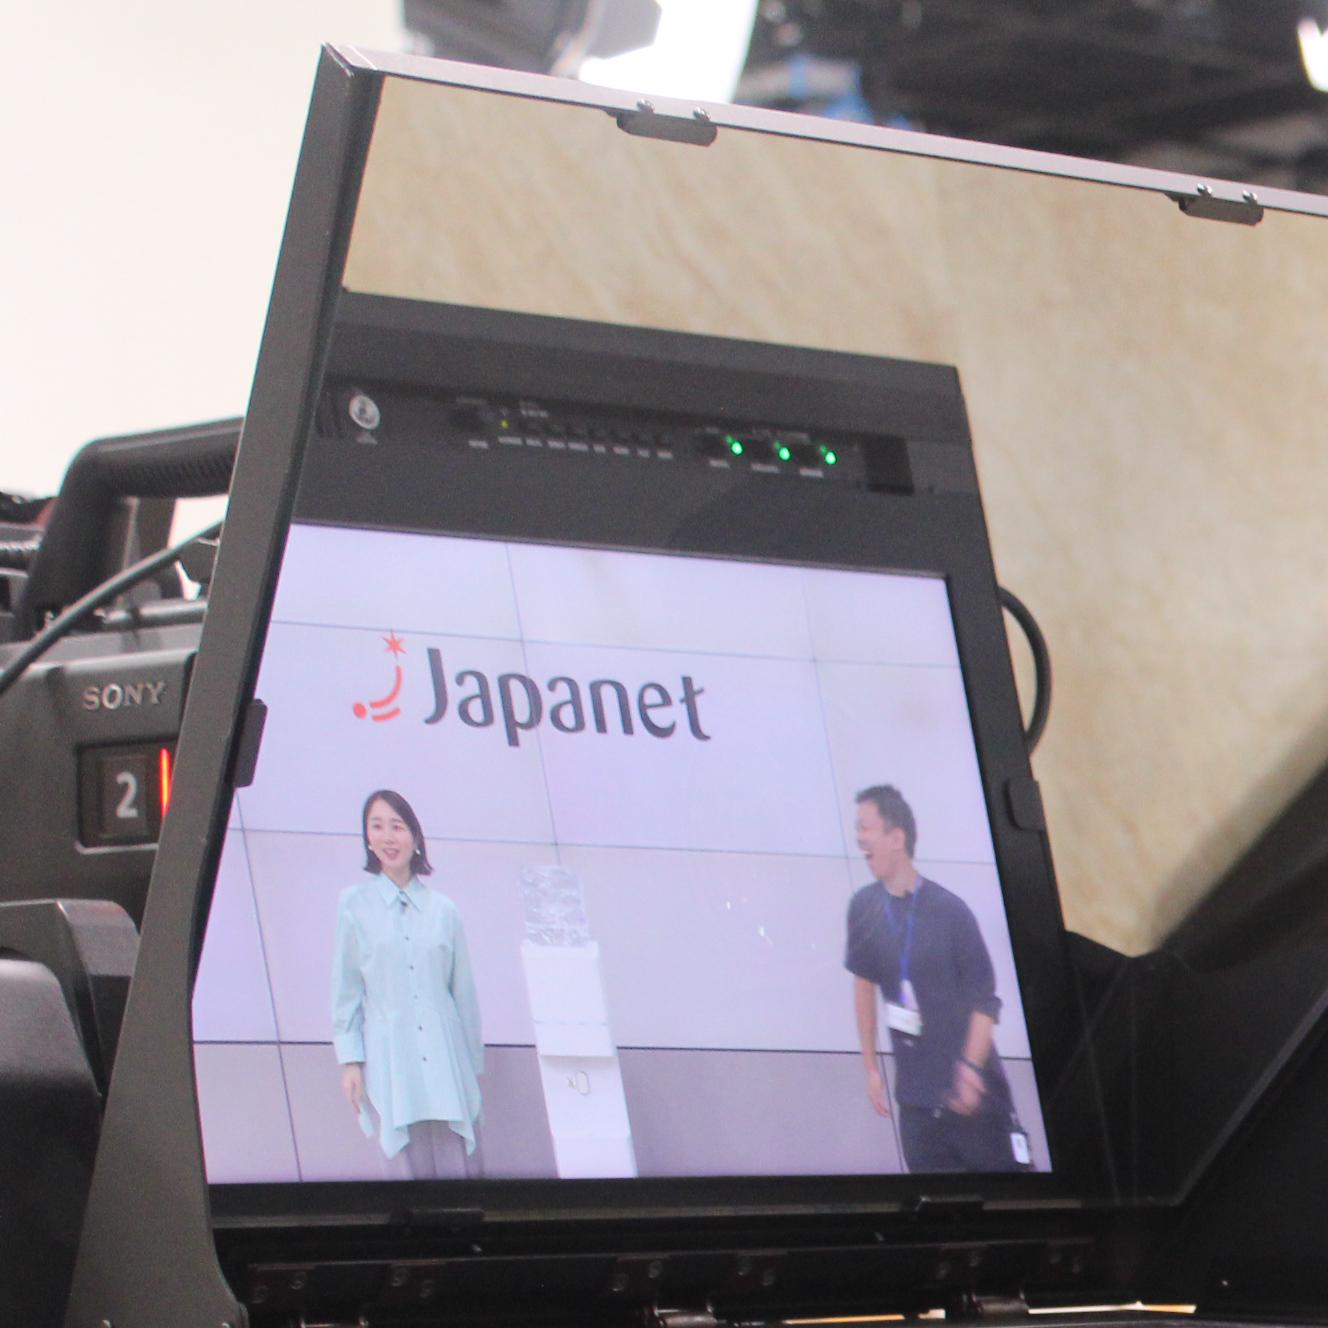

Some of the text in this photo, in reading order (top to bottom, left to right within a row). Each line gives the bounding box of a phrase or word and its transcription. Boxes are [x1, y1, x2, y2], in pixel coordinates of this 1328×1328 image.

[82, 681, 165, 710] SONY
[424, 647, 711, 748] Japanet
[116, 771, 138, 818] 2
